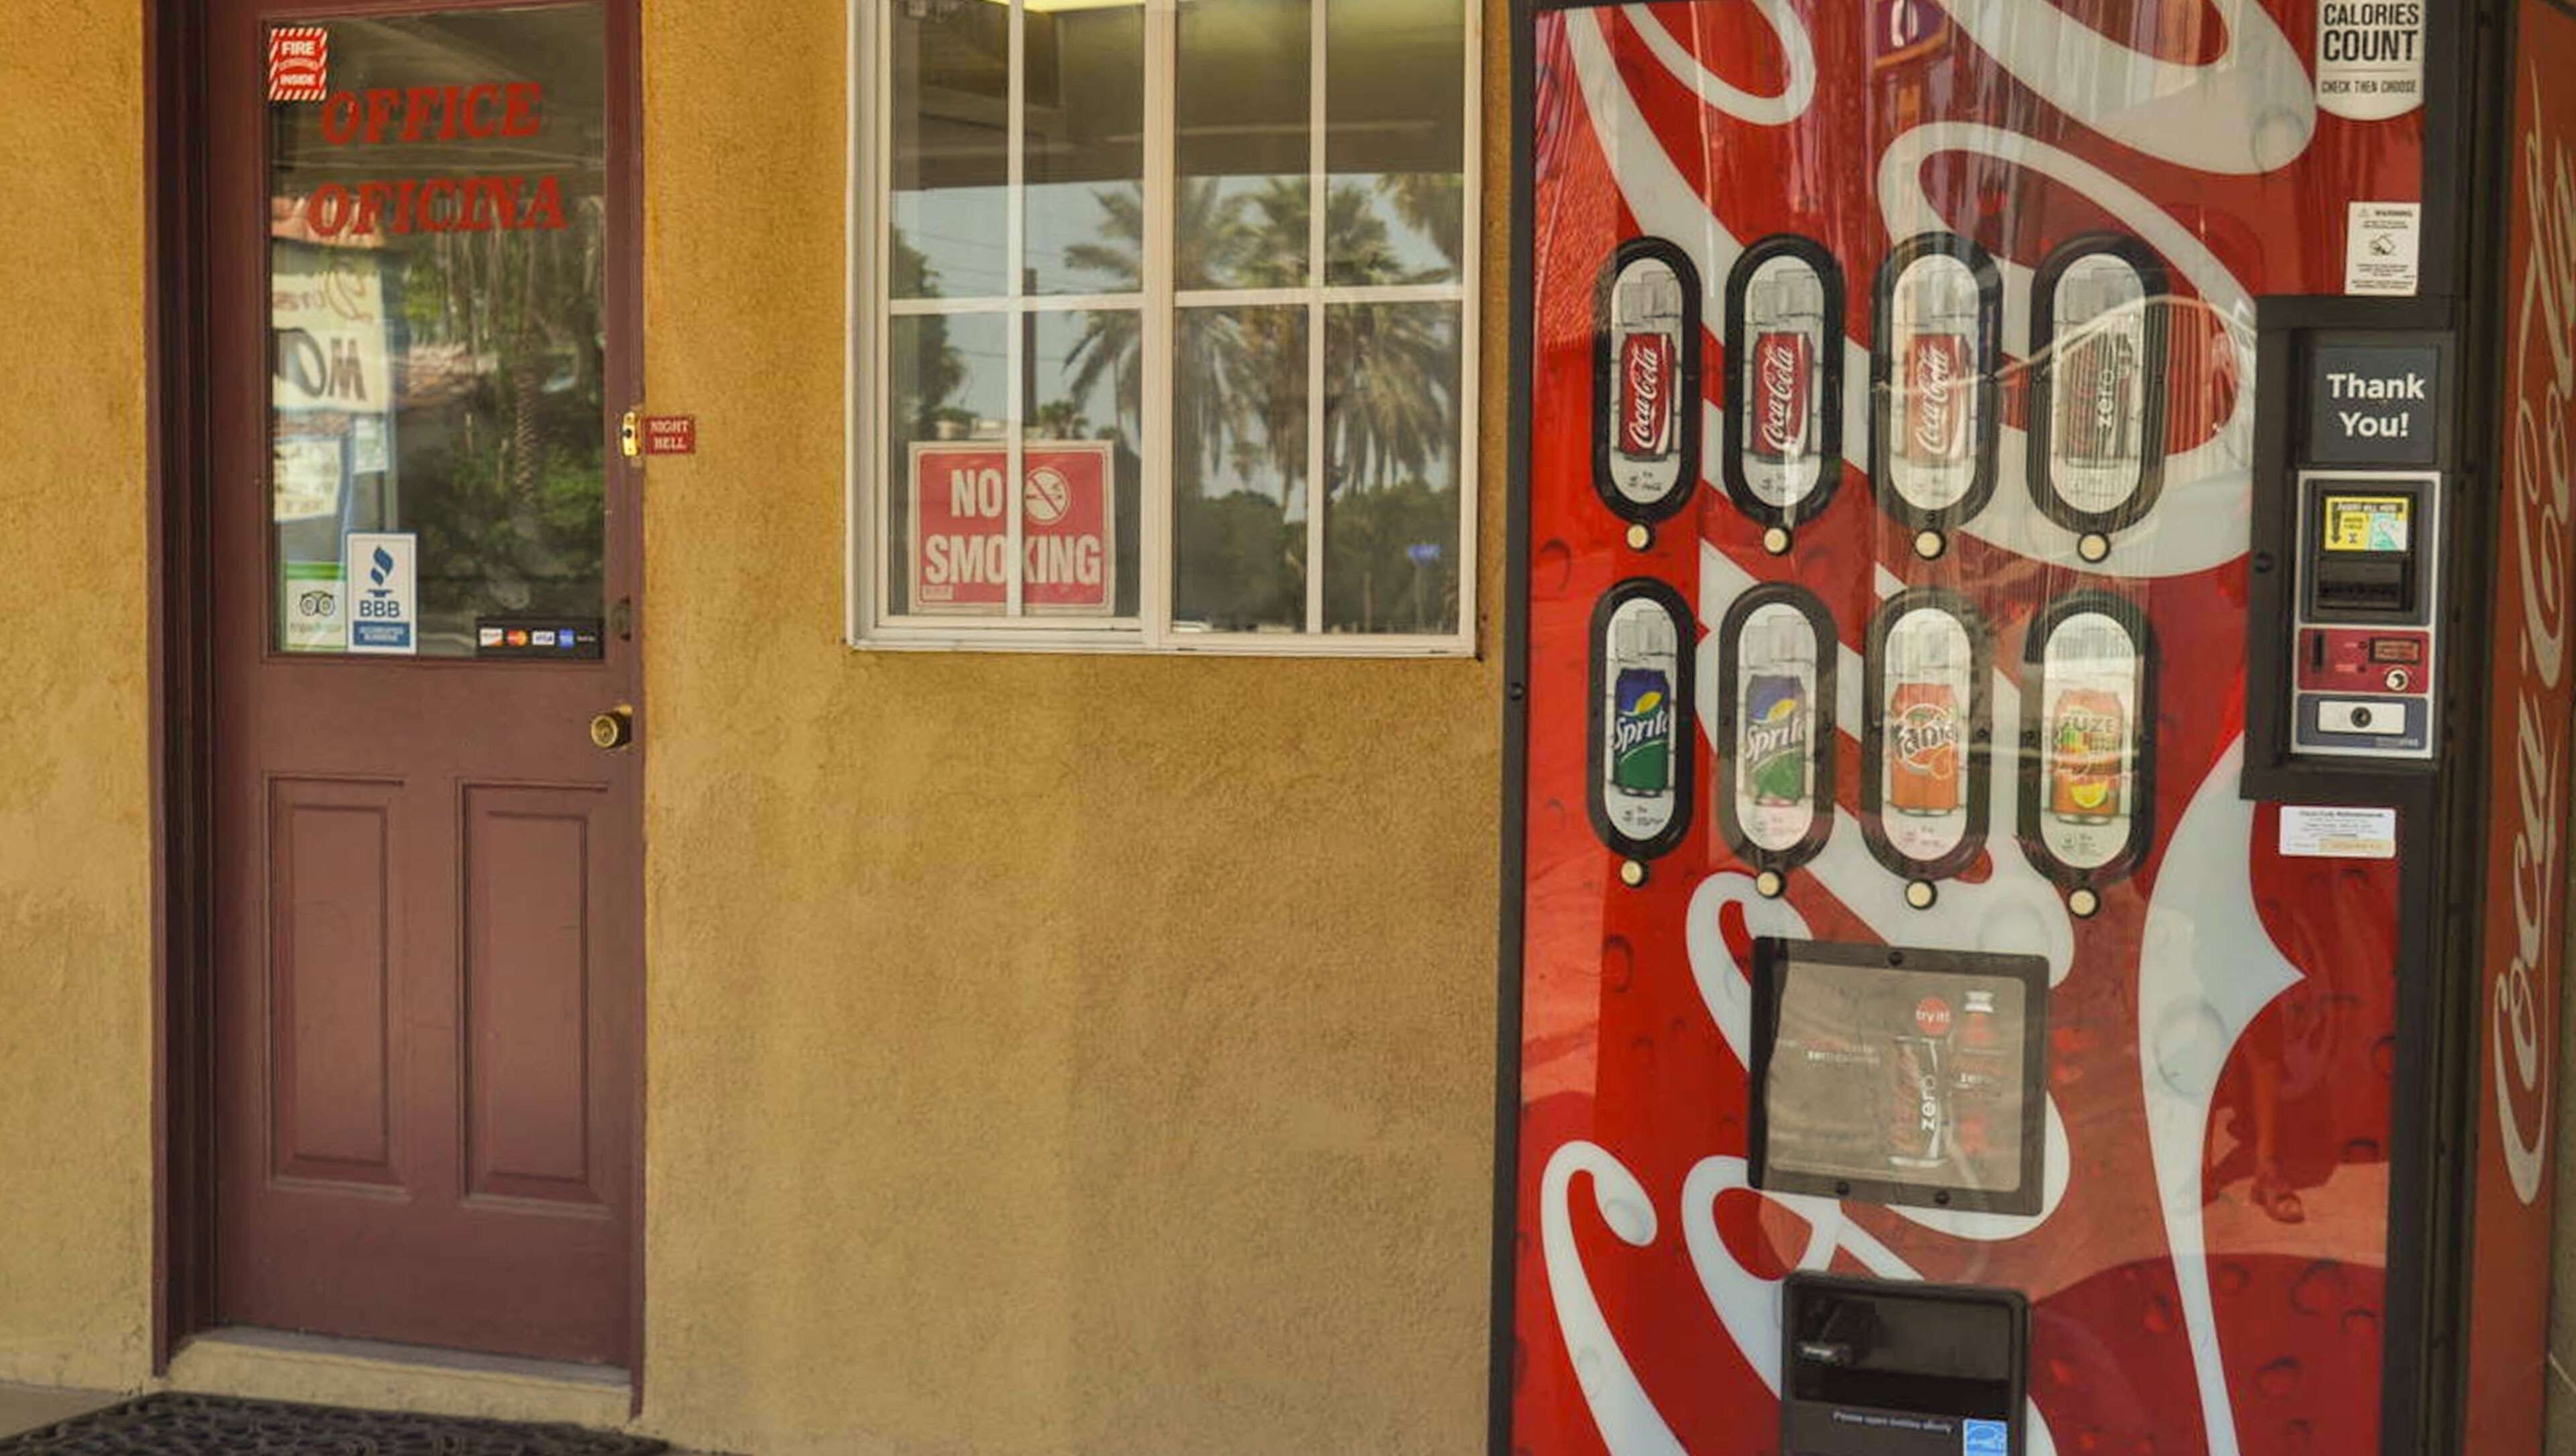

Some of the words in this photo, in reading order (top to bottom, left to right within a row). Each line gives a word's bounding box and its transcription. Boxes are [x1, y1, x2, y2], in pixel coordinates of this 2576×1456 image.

[2324, 3, 2419, 26] CALORIES
[281, 40, 316, 56] FIRE
[2323, 30, 2418, 61] COUNT
[280, 73, 316, 87] INSIDE
[2321, 80, 2351, 93] CHECK
[2355, 80, 2377, 93] THEN
[2381, 80, 2416, 93] CHOOSE
[323, 83, 541, 144] OFFICE
[308, 175, 566, 236] OFICINA
[1629, 341, 1658, 448] Coca-Cola
[2326, 372, 2425, 400] Thank
[2097, 370, 2114, 437] zero
[650, 420, 688, 433] NIGHT
[2339, 411, 2410, 437] You!
[654, 437, 687, 451] BELL
[951, 468, 1003, 518] NO
[925, 534, 1102, 585] SMOKING
[360, 601, 400, 618] BBB
[1916, 1008, 1936, 1023] try
[1919, 1075, 1936, 1133] zero
